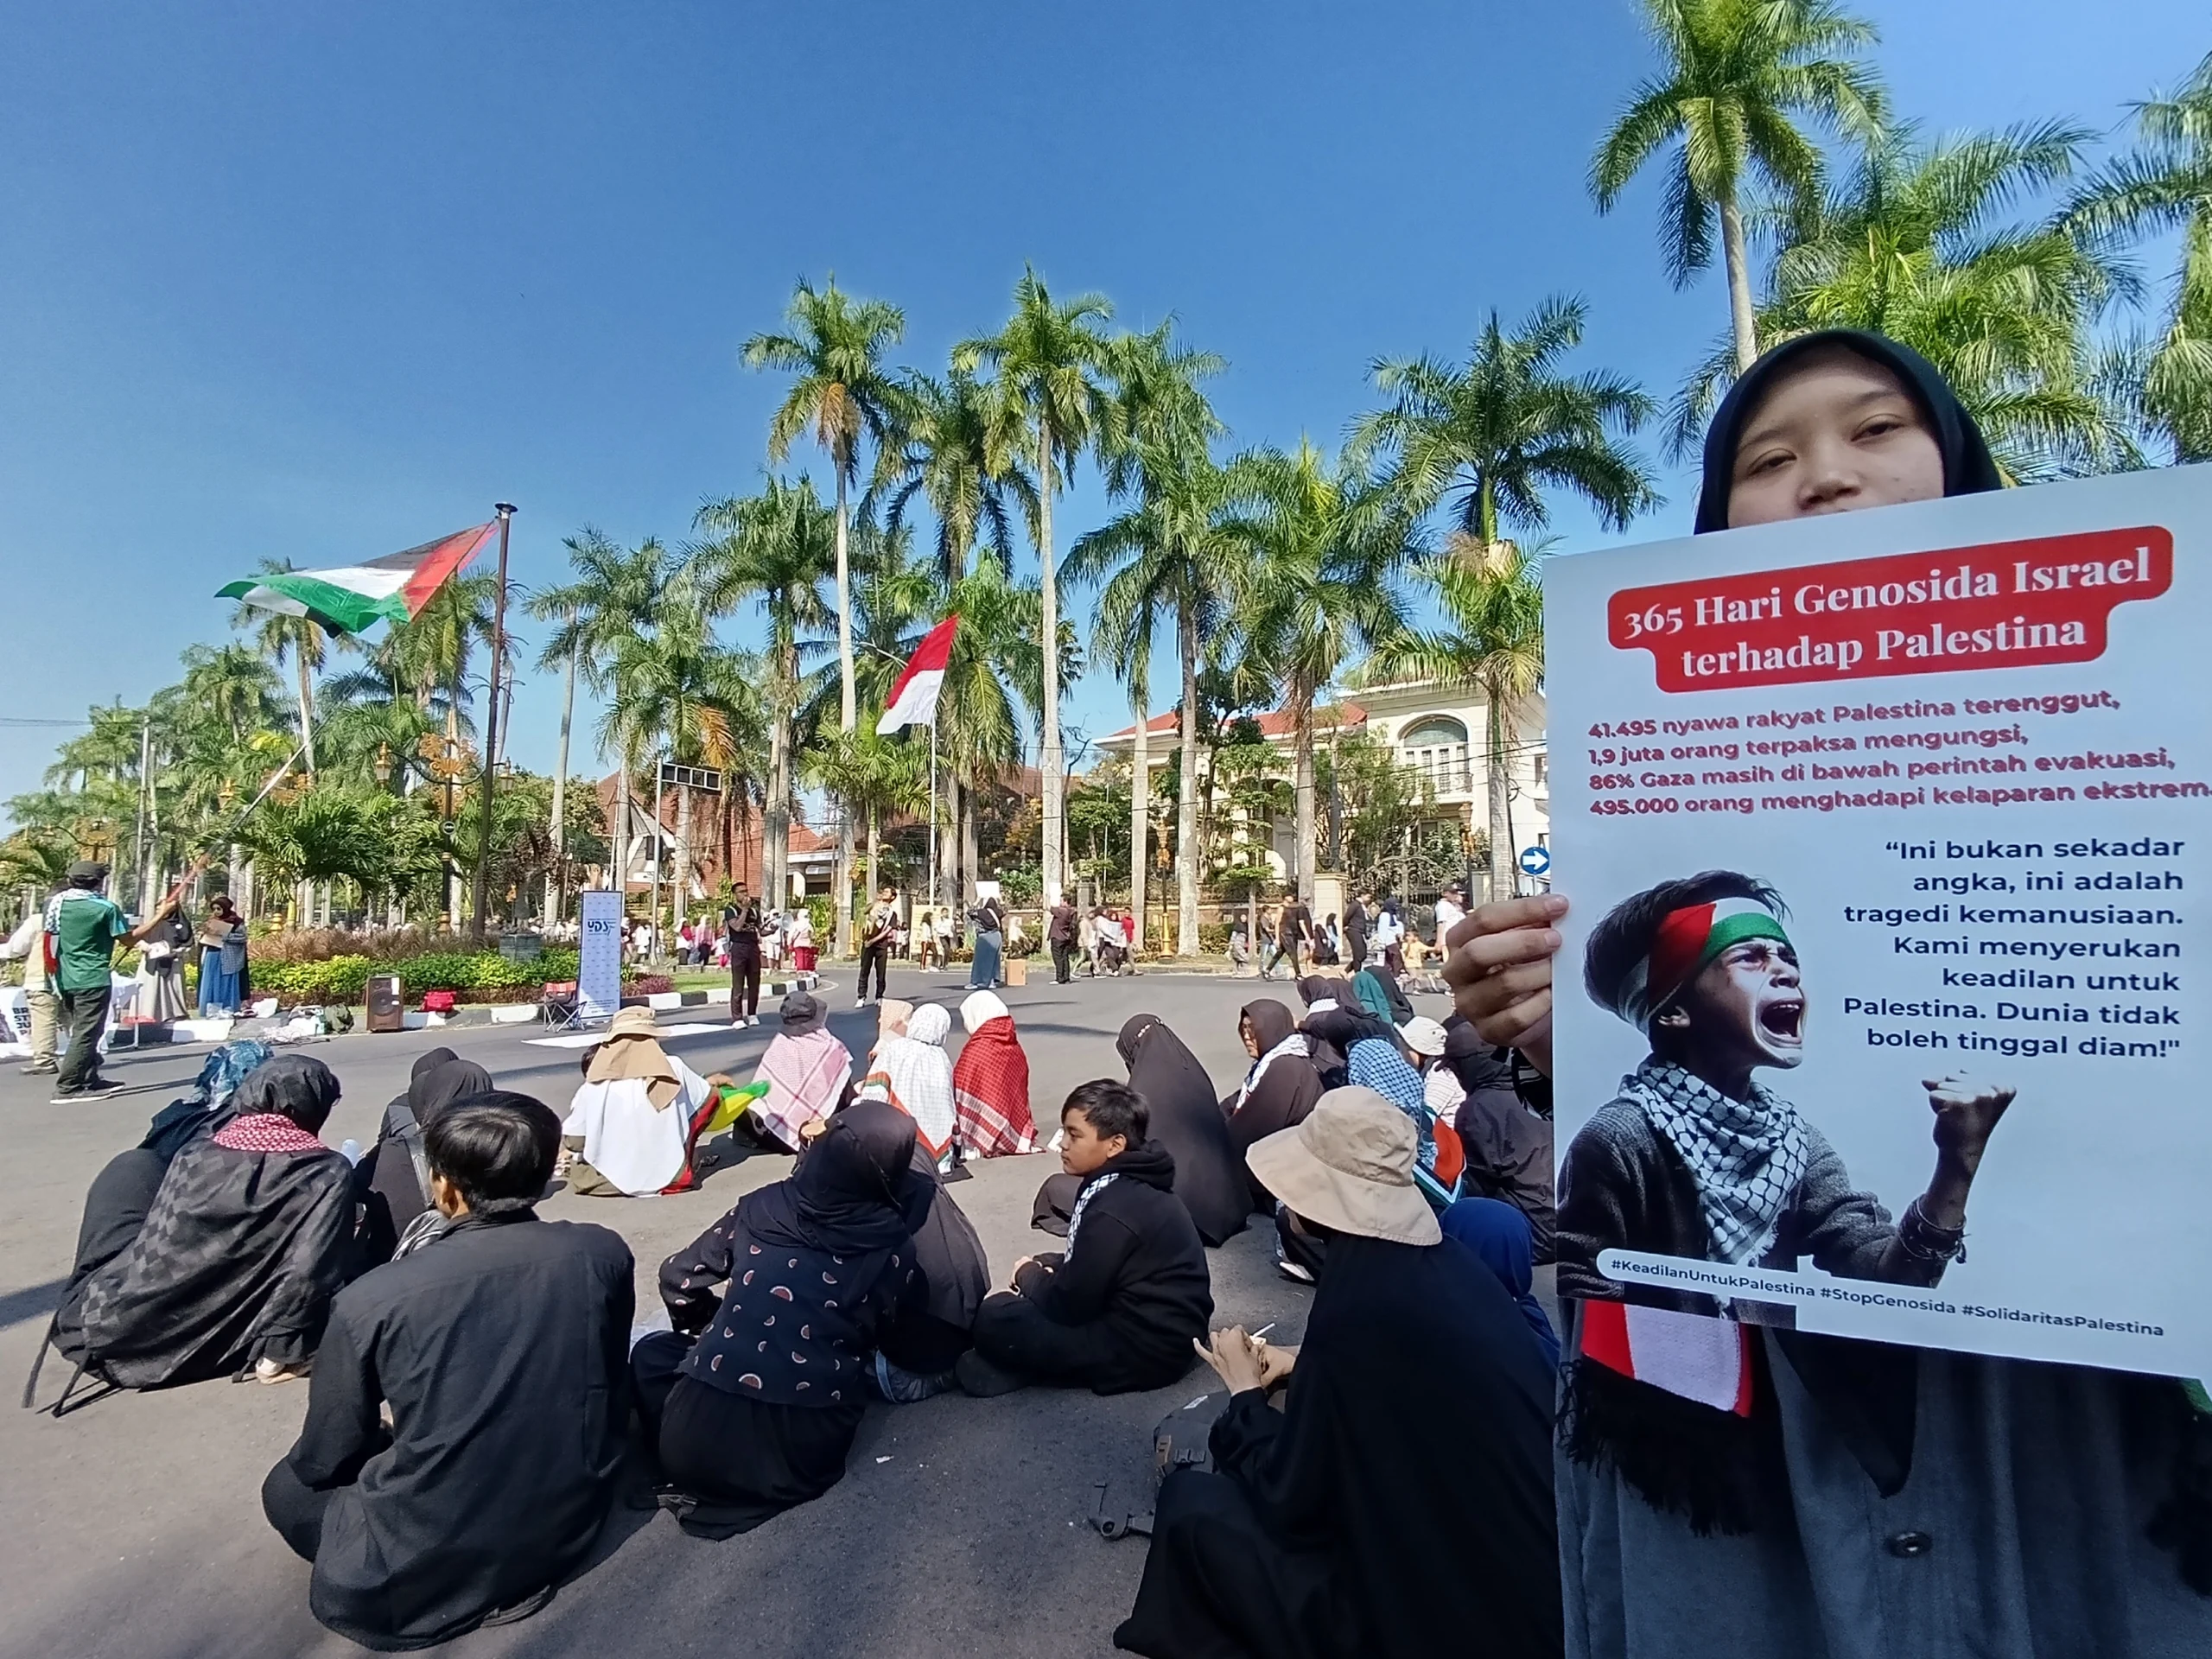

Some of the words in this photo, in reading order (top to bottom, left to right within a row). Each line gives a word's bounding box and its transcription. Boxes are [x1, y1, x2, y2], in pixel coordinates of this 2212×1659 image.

[1625, 604, 1682, 639] 365
[1695, 588, 1782, 626] Hari
[1795, 566, 1999, 613] Genosida
[2013, 547, 2150, 593] Israel
[1683, 636, 1862, 677] terhadap
[1877, 616, 2086, 659] Palestina
[1588, 720, 1656, 738] 41.495
[1663, 717, 1738, 736] nyawa
[1747, 709, 1826, 729] rakyat
[1834, 700, 1955, 722] Palestina
[1963, 690, 2120, 715] terenggut,
[1588, 749, 1616, 766] 1,9
[1619, 747, 1664, 766] juta
[1671, 744, 1738, 760] orang
[1746, 735, 1856, 757] terpaksa
[1865, 723, 2028, 750] mengungsi,
[1590, 773, 1635, 790] 86%
[1640, 772, 1694, 787] Gaza
[1702, 766, 1774, 785] masih
[1782, 764, 1804, 781] di
[1813, 760, 1899, 779] bawah
[1908, 754, 2026, 779] perintah
[2035, 747, 2175, 771] evakuasi,
[1590, 798, 1679, 815] 495.000
[1685, 798, 1753, 814] orang
[1762, 787, 1924, 811] menghadapi
[1934, 786, 2075, 806] kelaparan
[1947, 840, 2043, 858] bukan
[2054, 837, 2184, 857] sekadar
[1914, 873, 2015, 894] angka,
[2026, 871, 2063, 890] ini
[2075, 871, 2183, 890] adalah
[1844, 905, 1948, 926] tragedi
[1961, 905, 2183, 924] kemanusiaan.
[1895, 936, 1967, 954] Kami
[1980, 938, 2180, 960] menyerukan
[1943, 969, 2074, 988] keadilan
[2088, 972, 2179, 990] untuk
[1845, 998, 1986, 1019] Palestina.
[1998, 1002, 2088, 1022] Dunia
[2099, 1005, 2179, 1024] tidak
[1868, 1028, 1948, 1048] boleh
[1958, 1032, 2067, 1057] tinggal
[2079, 1037, 2179, 1057] diam!"
[1611, 1259, 1815, 1297] #KeadilanUntukPalestina
[1821, 1288, 1955, 1313] #StopGenosida
[1962, 1305, 2164, 1336] #SolidaritasPalestina
